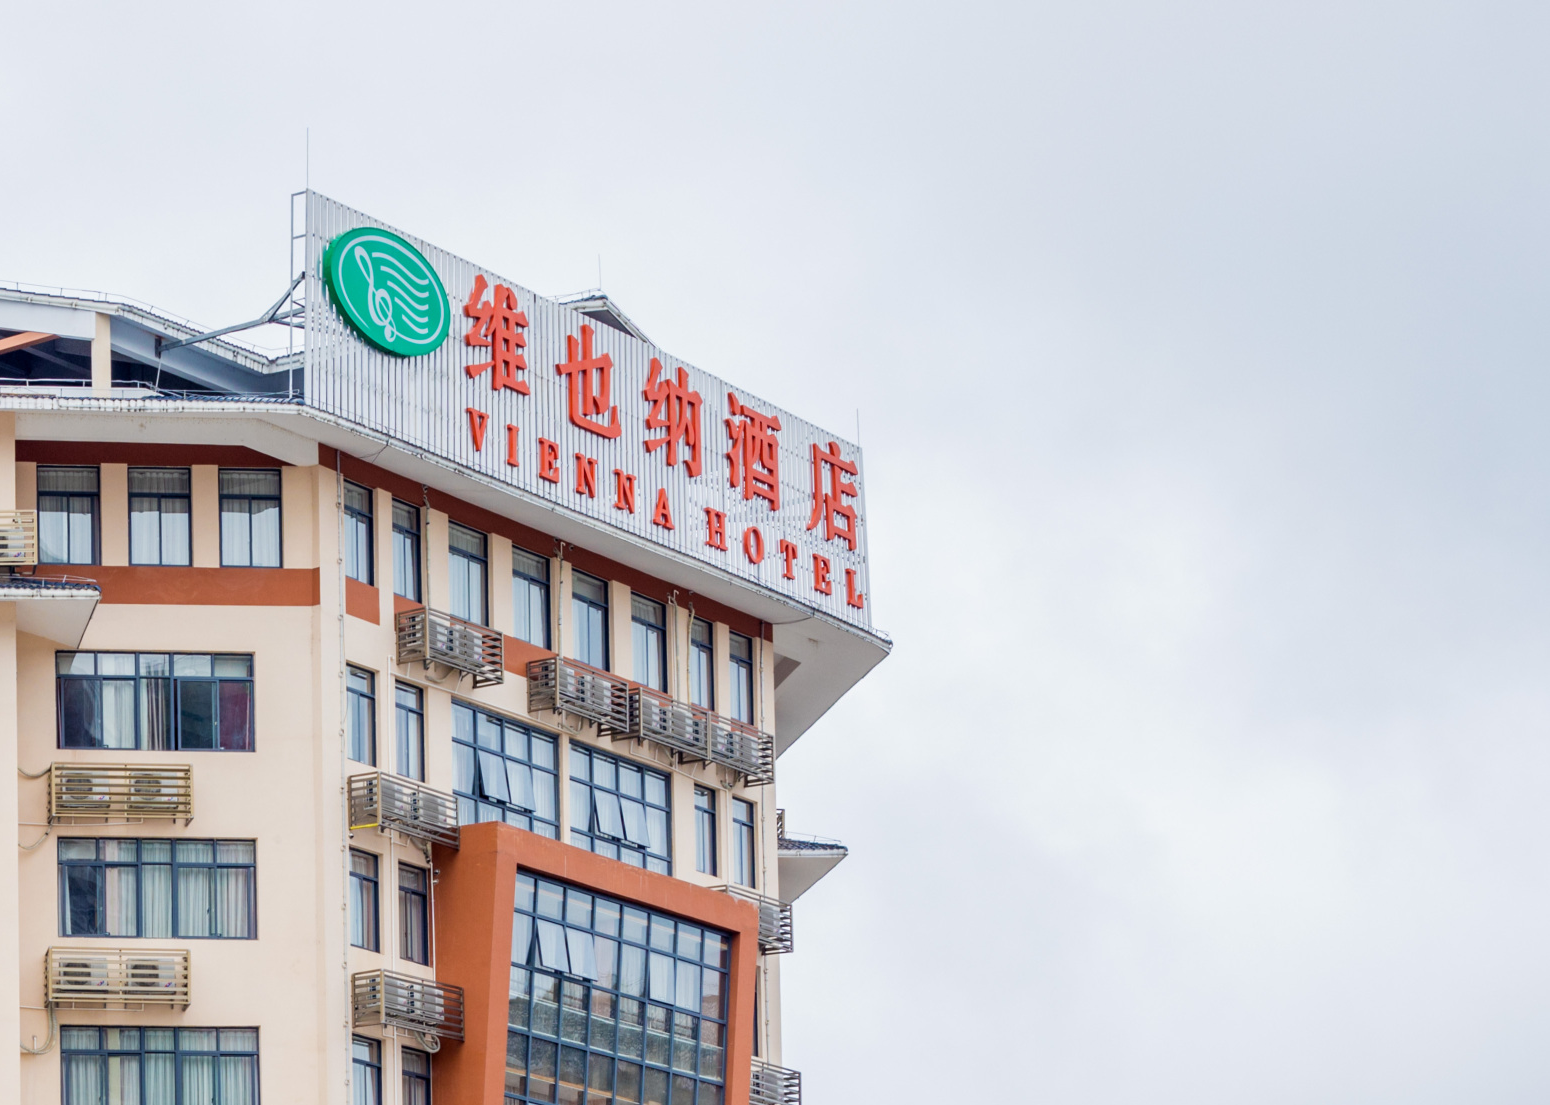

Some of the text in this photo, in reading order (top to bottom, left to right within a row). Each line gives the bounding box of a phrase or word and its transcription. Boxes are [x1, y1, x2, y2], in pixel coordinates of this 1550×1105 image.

[463, 274, 858, 551] 维也纳酒店
[466, 407, 865, 609] VIENNA HOTEL
